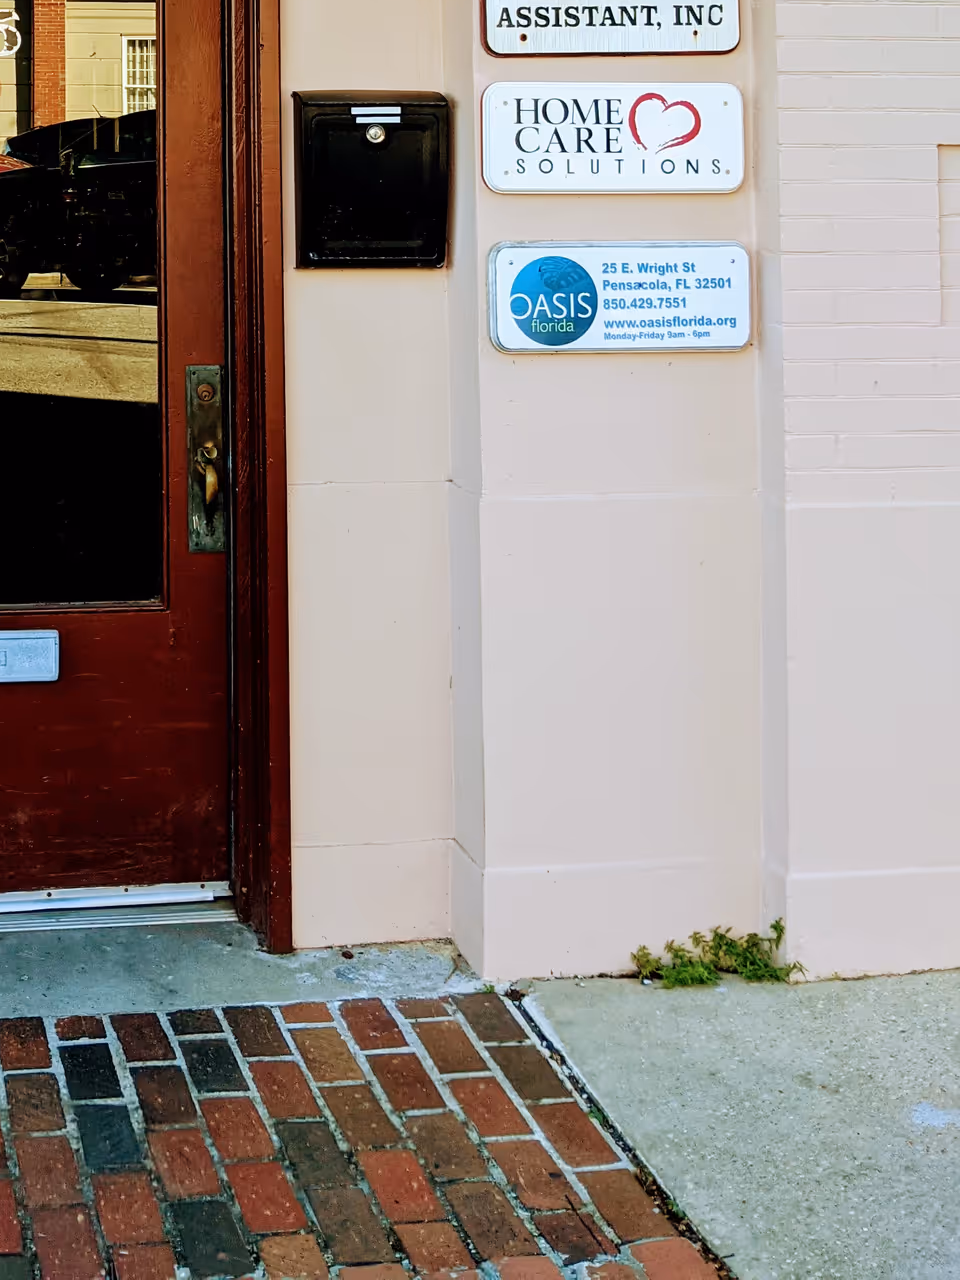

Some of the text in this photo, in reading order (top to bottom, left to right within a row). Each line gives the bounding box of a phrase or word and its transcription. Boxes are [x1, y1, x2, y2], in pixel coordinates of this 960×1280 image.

[496, 4, 724, 31] ASSISTANT, INC
[514, 98, 624, 125] HOME
[514, 126, 624, 153] CARE
[516, 158, 721, 175] SOLUTIONS
[602, 262, 697, 276] 25 E. Wright St
[602, 277, 732, 292] Pensacola, FL 32501
[509, 292, 593, 320] OASIS
[603, 297, 687, 310] 850.429.7551
[531, 318, 575, 333] florida
[603, 316, 737, 328] www.oasisflorida.org
[603, 331, 665, 341] Monday-Friday
[667, 331, 686, 339] 9am
[692, 329, 711, 340] 6pm
